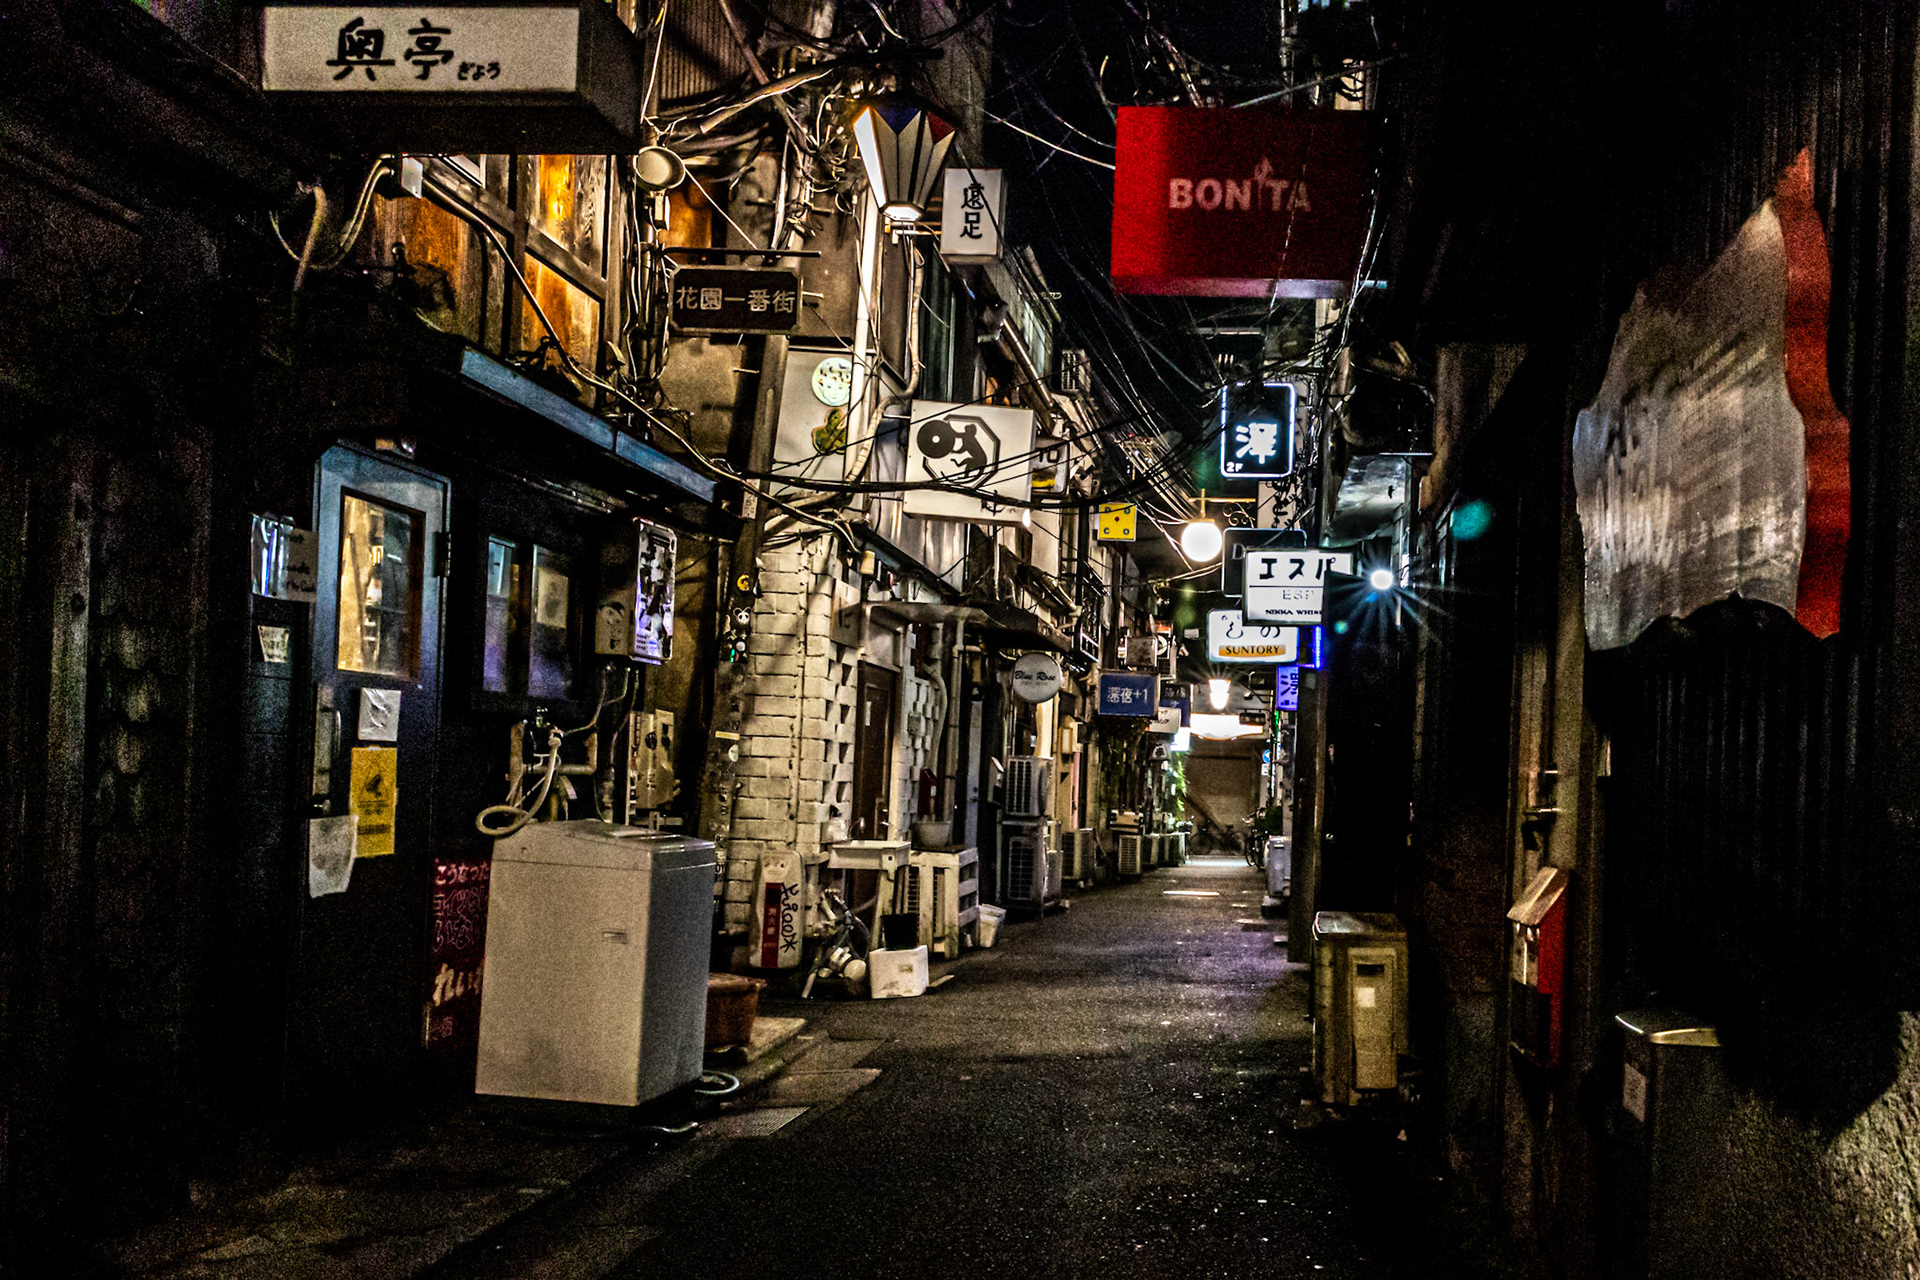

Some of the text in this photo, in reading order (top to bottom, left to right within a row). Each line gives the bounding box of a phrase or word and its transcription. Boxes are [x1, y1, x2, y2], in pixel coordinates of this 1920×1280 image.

[960, 183, 984, 239] 遠足
[676, 286, 795, 313] 花園一番街
[1226, 462, 1243, 472] 2F
[1260, 557, 1337, 580] エスパ
[1225, 645, 1280, 655] SUNTORY
[1107, 686, 1148, 704] 深夜+1
